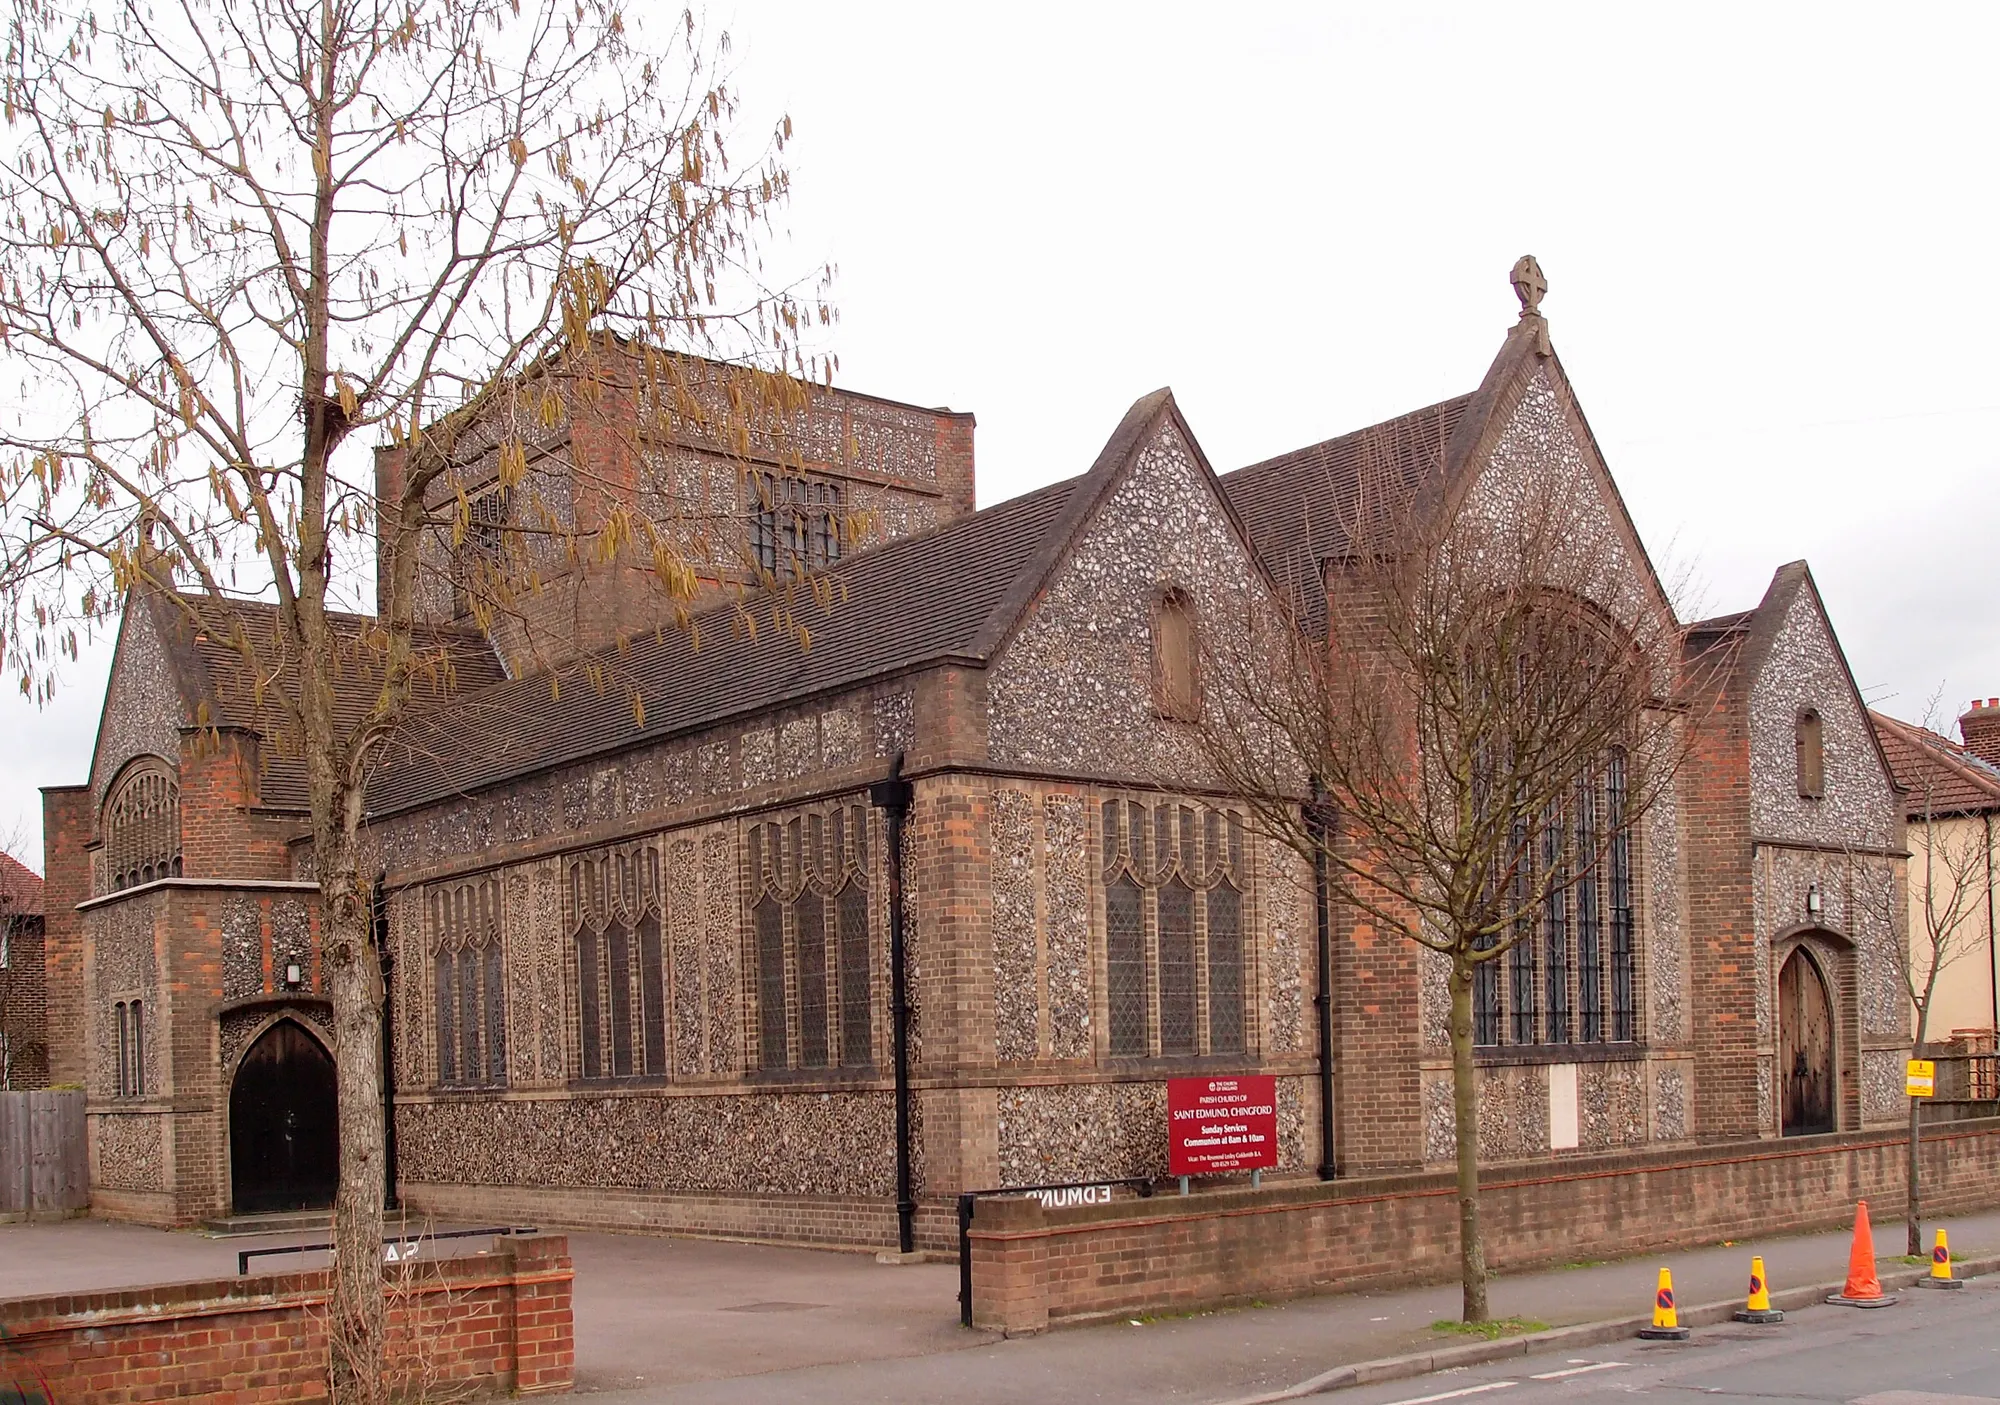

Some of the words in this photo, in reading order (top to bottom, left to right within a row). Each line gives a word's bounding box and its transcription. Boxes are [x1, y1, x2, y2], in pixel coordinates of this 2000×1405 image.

[1199, 1096, 1217, 1104] PARISH
[1217, 1095, 1239, 1103] CHURCH
[1240, 1094, 1247, 1102] OF
[1174, 1109, 1195, 1120] SAINT
[1196, 1107, 1230, 1119] EDMUND,
[1230, 1105, 1272, 1117] CHINGFORD
[1201, 1124, 1223, 1135] Sunday
[1224, 1123, 1248, 1133] Services
[1184, 1136, 1220, 1147] Communion
[1221, 1136, 1228, 1144] at
[1228, 1135, 1241, 1144] 8am
[1242, 1134, 1248, 1143] &
[1248, 1134, 1265, 1143] 10am
